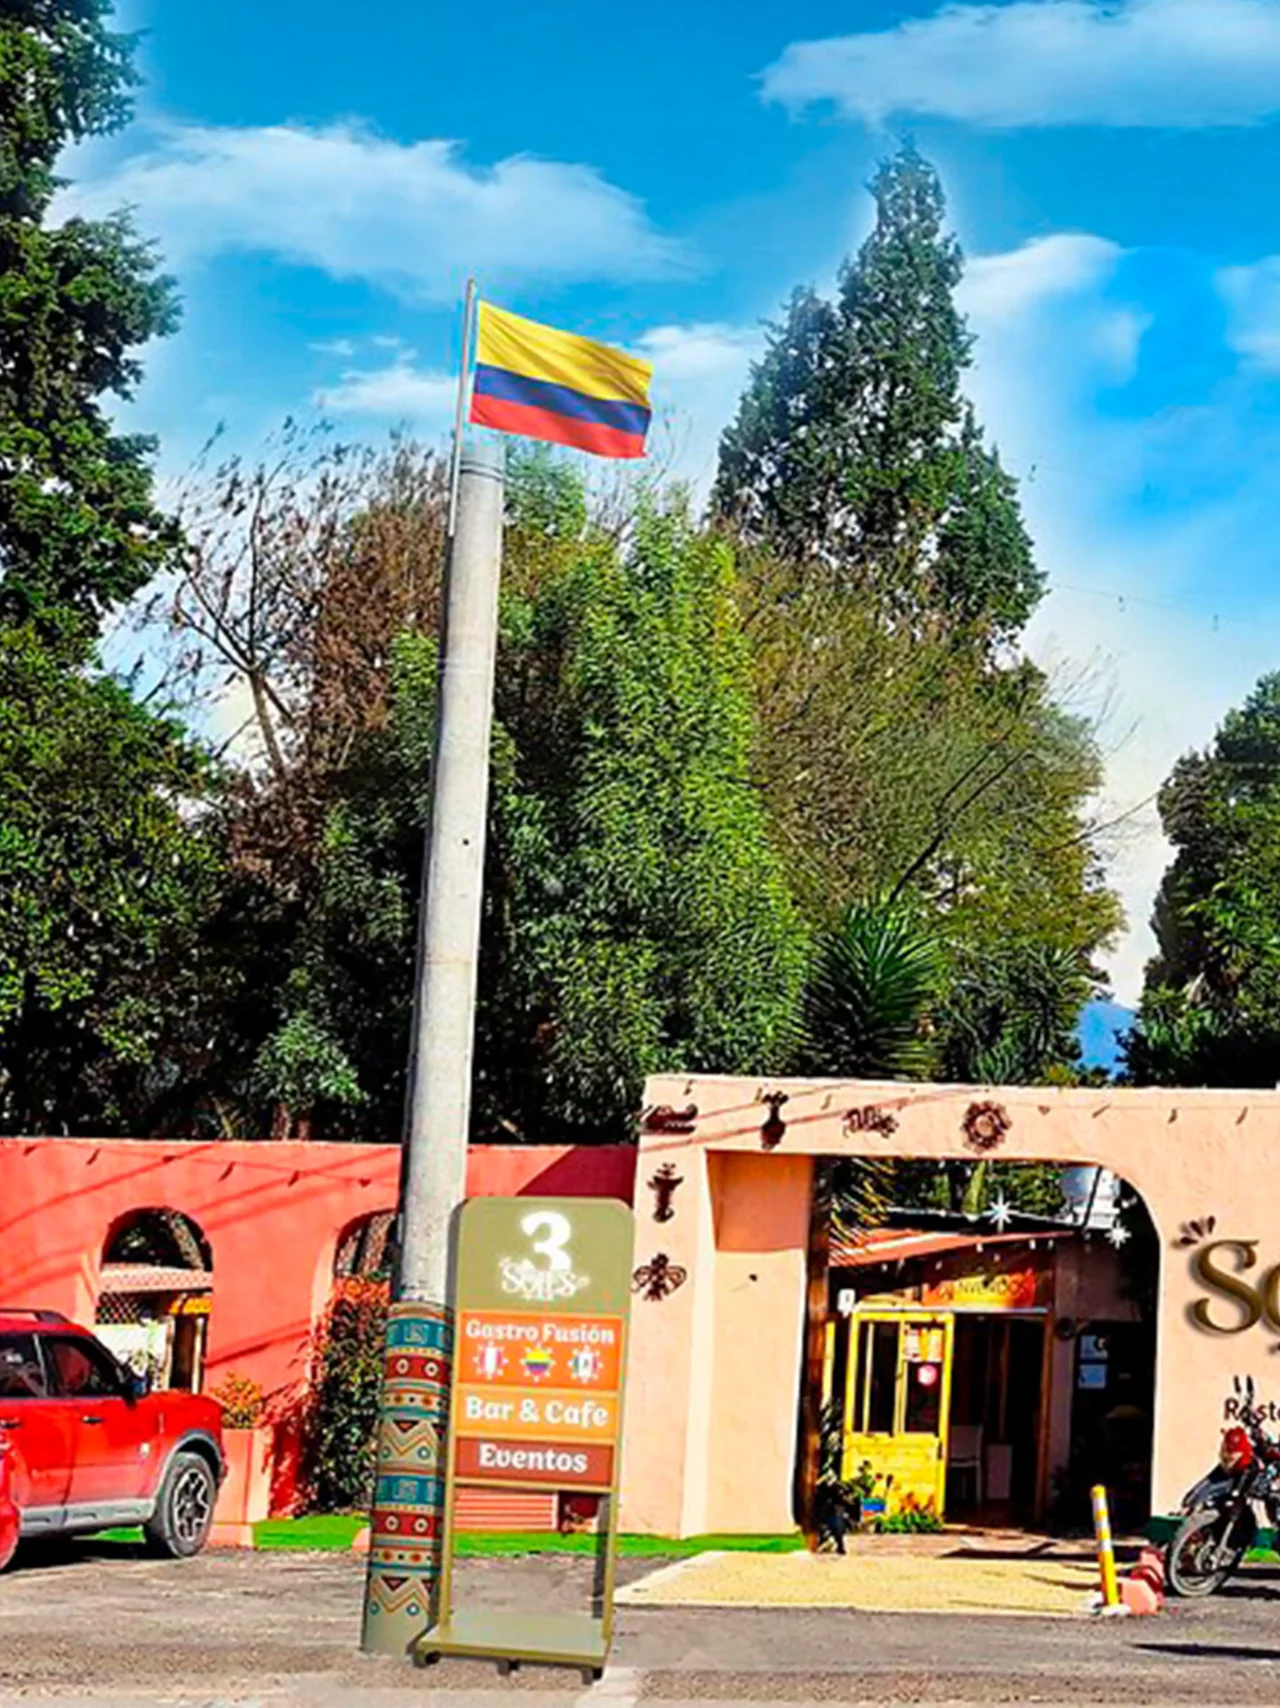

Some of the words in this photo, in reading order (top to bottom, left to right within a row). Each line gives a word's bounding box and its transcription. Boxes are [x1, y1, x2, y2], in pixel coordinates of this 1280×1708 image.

[520, 1211, 572, 1272] 3
[466, 1320, 538, 1341] Gastro
[543, 1324, 615, 1345] Fusión
[466, 1396, 513, 1420] Bar
[519, 1400, 540, 1424] &
[545, 1401, 609, 1428] Cafe
[479, 1442, 588, 1473] Eventos
